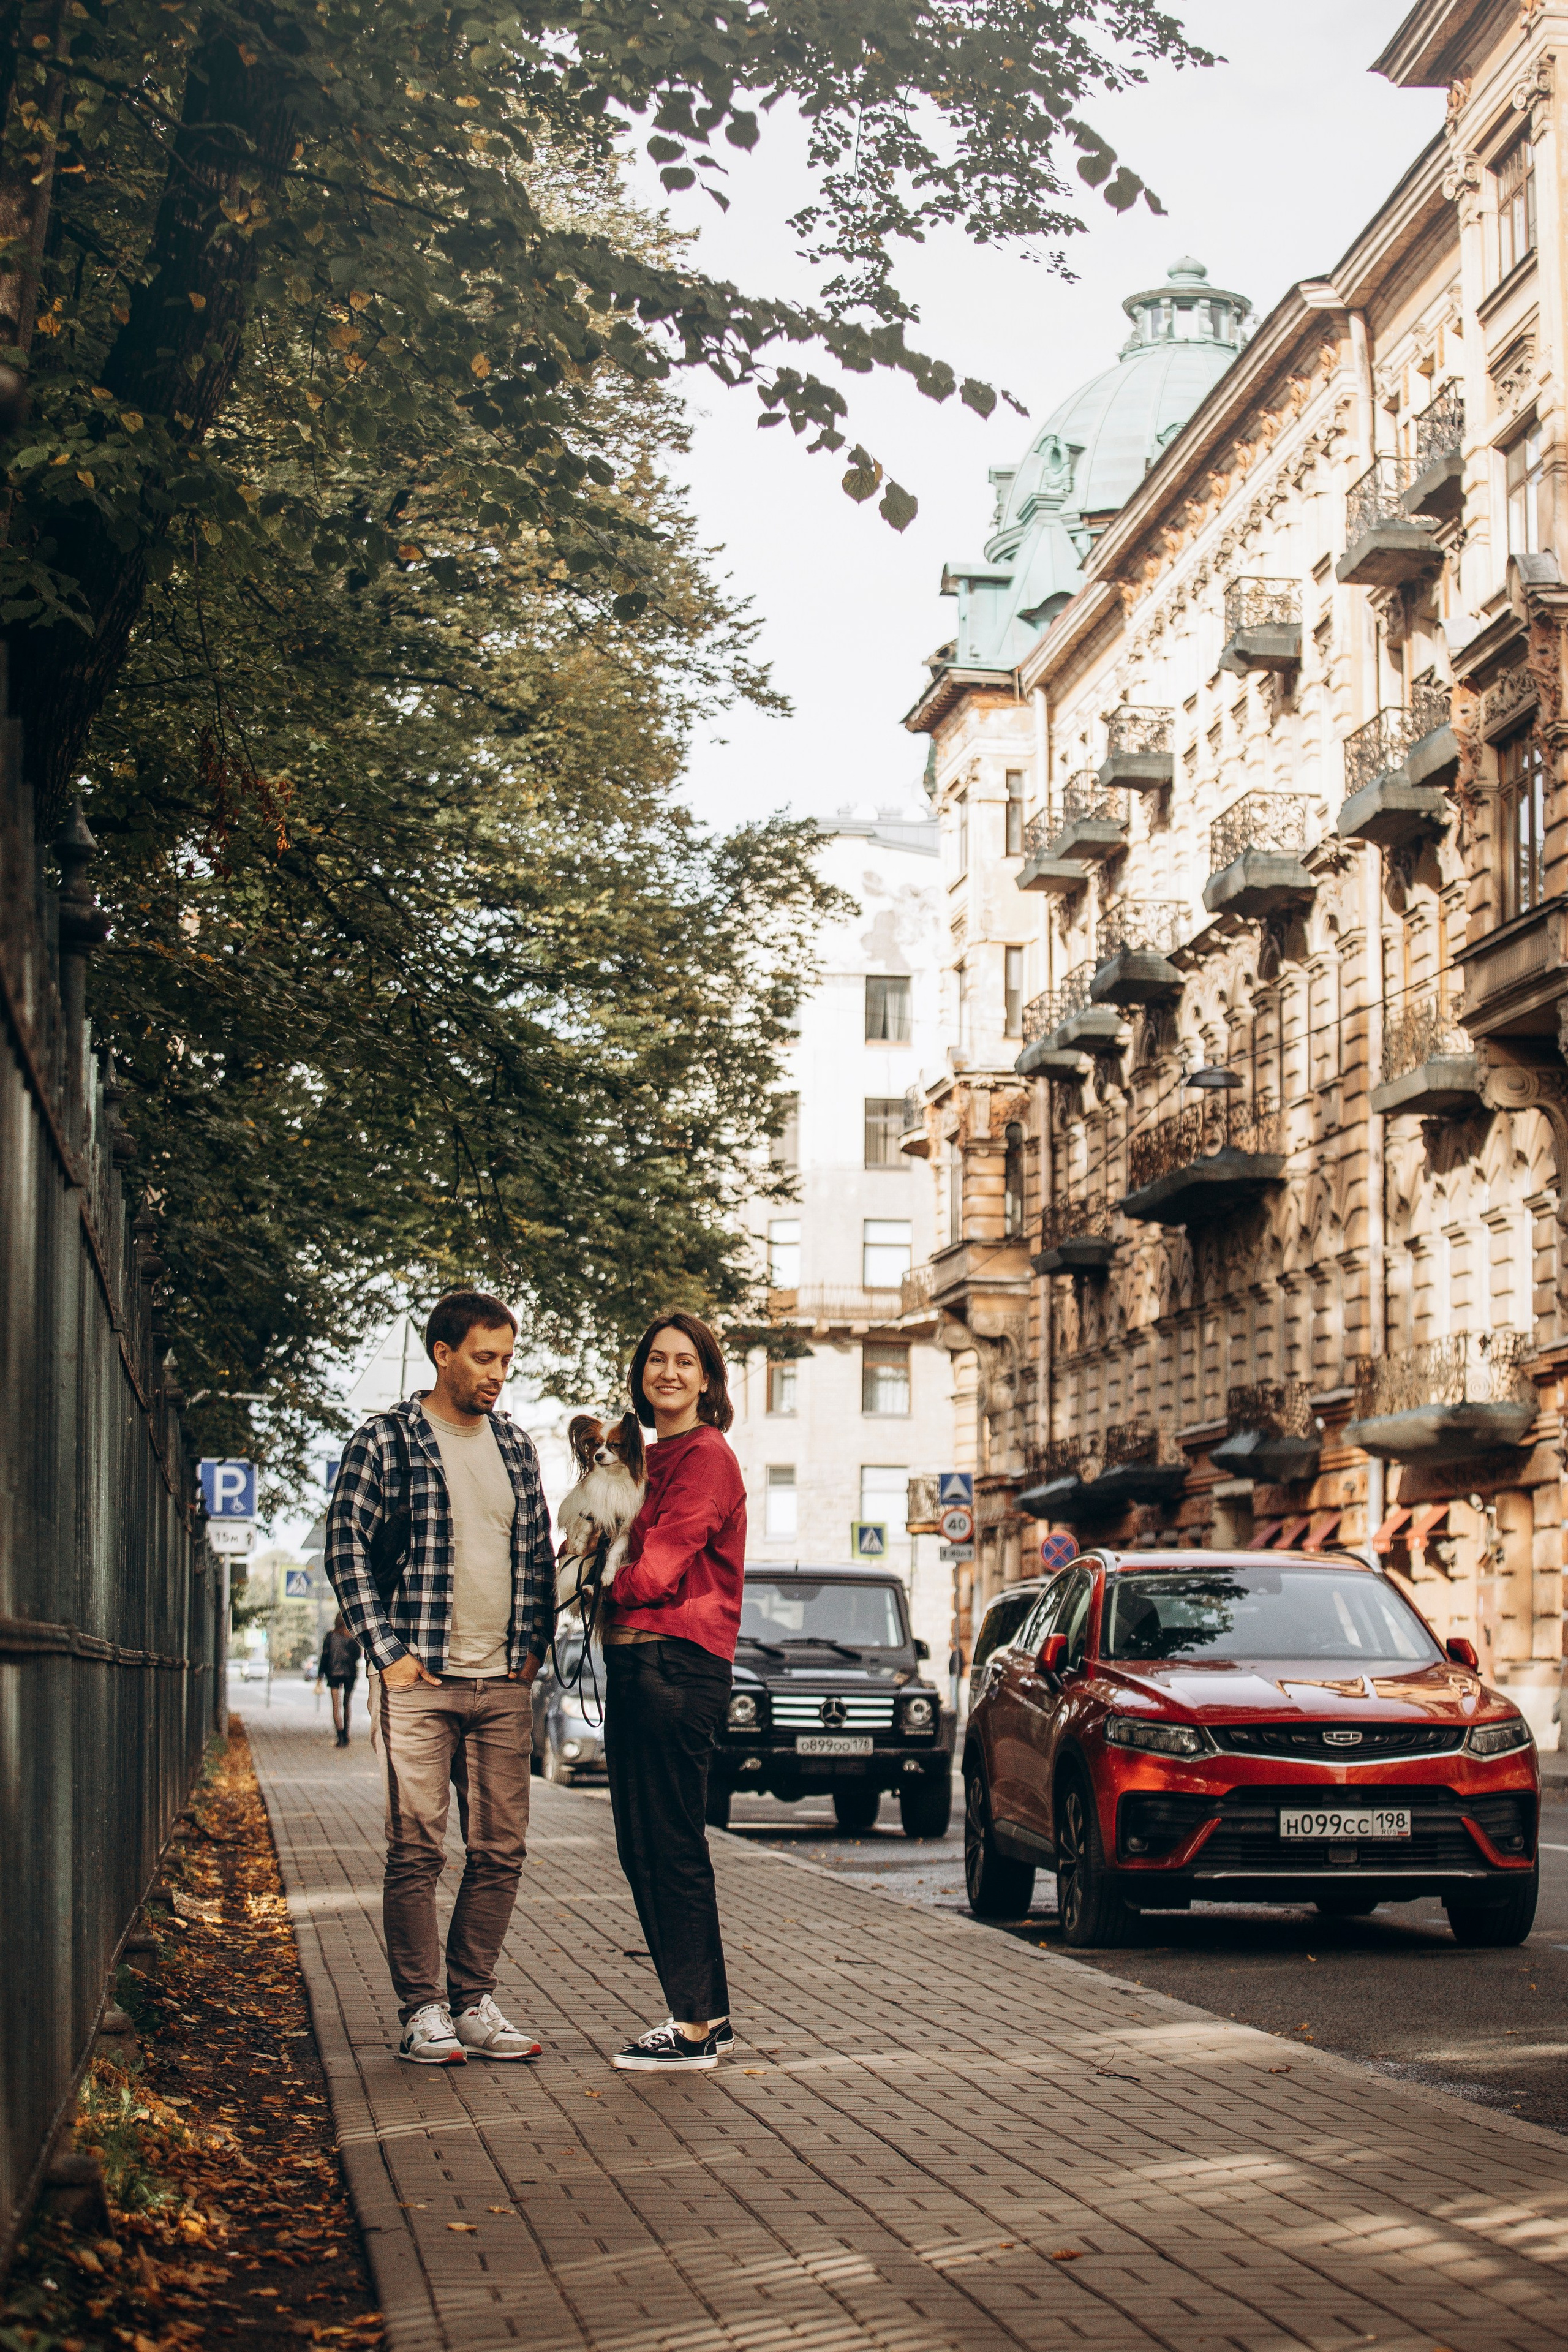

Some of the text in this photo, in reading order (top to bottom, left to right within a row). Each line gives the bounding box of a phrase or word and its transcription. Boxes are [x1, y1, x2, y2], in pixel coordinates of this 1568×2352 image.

[214, 1466, 247, 1513] P
[948, 1518, 966, 1530] 40
[1376, 1812, 1405, 1828] 198
